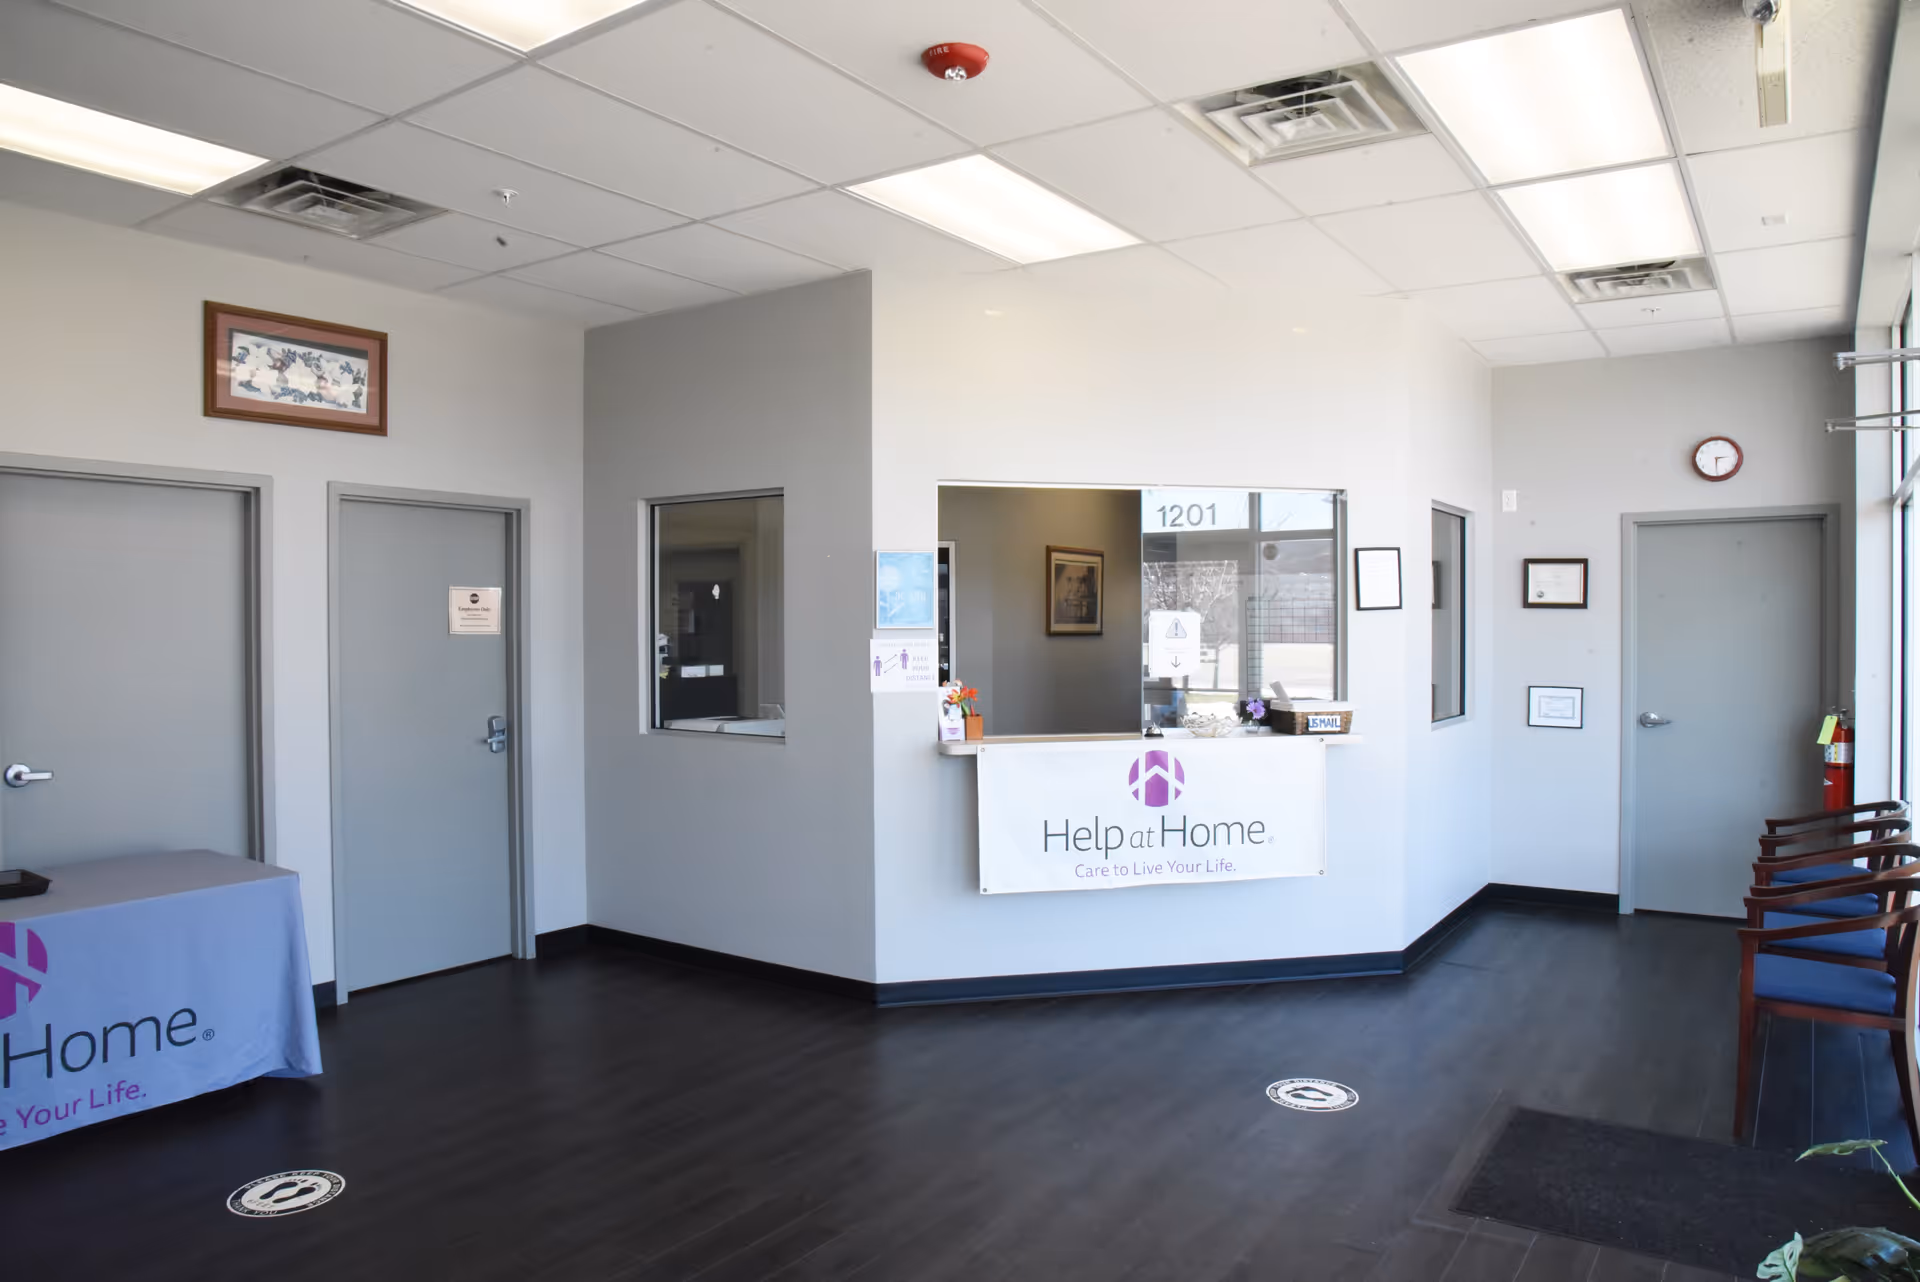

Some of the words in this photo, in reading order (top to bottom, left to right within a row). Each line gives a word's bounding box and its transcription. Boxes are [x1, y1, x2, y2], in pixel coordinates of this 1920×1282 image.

[929, 46, 950, 56] FIRE
[1157, 503, 1217, 528] 1201
[1308, 718, 1319, 728] US
[1320, 718, 1340, 728] MAIL
[1044, 816, 1124, 859] Help
[1130, 827, 1155, 848] at
[1161, 815, 1265, 848] Home
[1075, 864, 1109, 878] Care
[1112, 865, 1129, 876] to
[1133, 861, 1163, 876] Live
[1167, 860, 1201, 874] Your
[1206, 859, 1236, 873] Life.
[16, 1098, 81, 1129] Your
[90, 1080, 147, 1109] Life.
